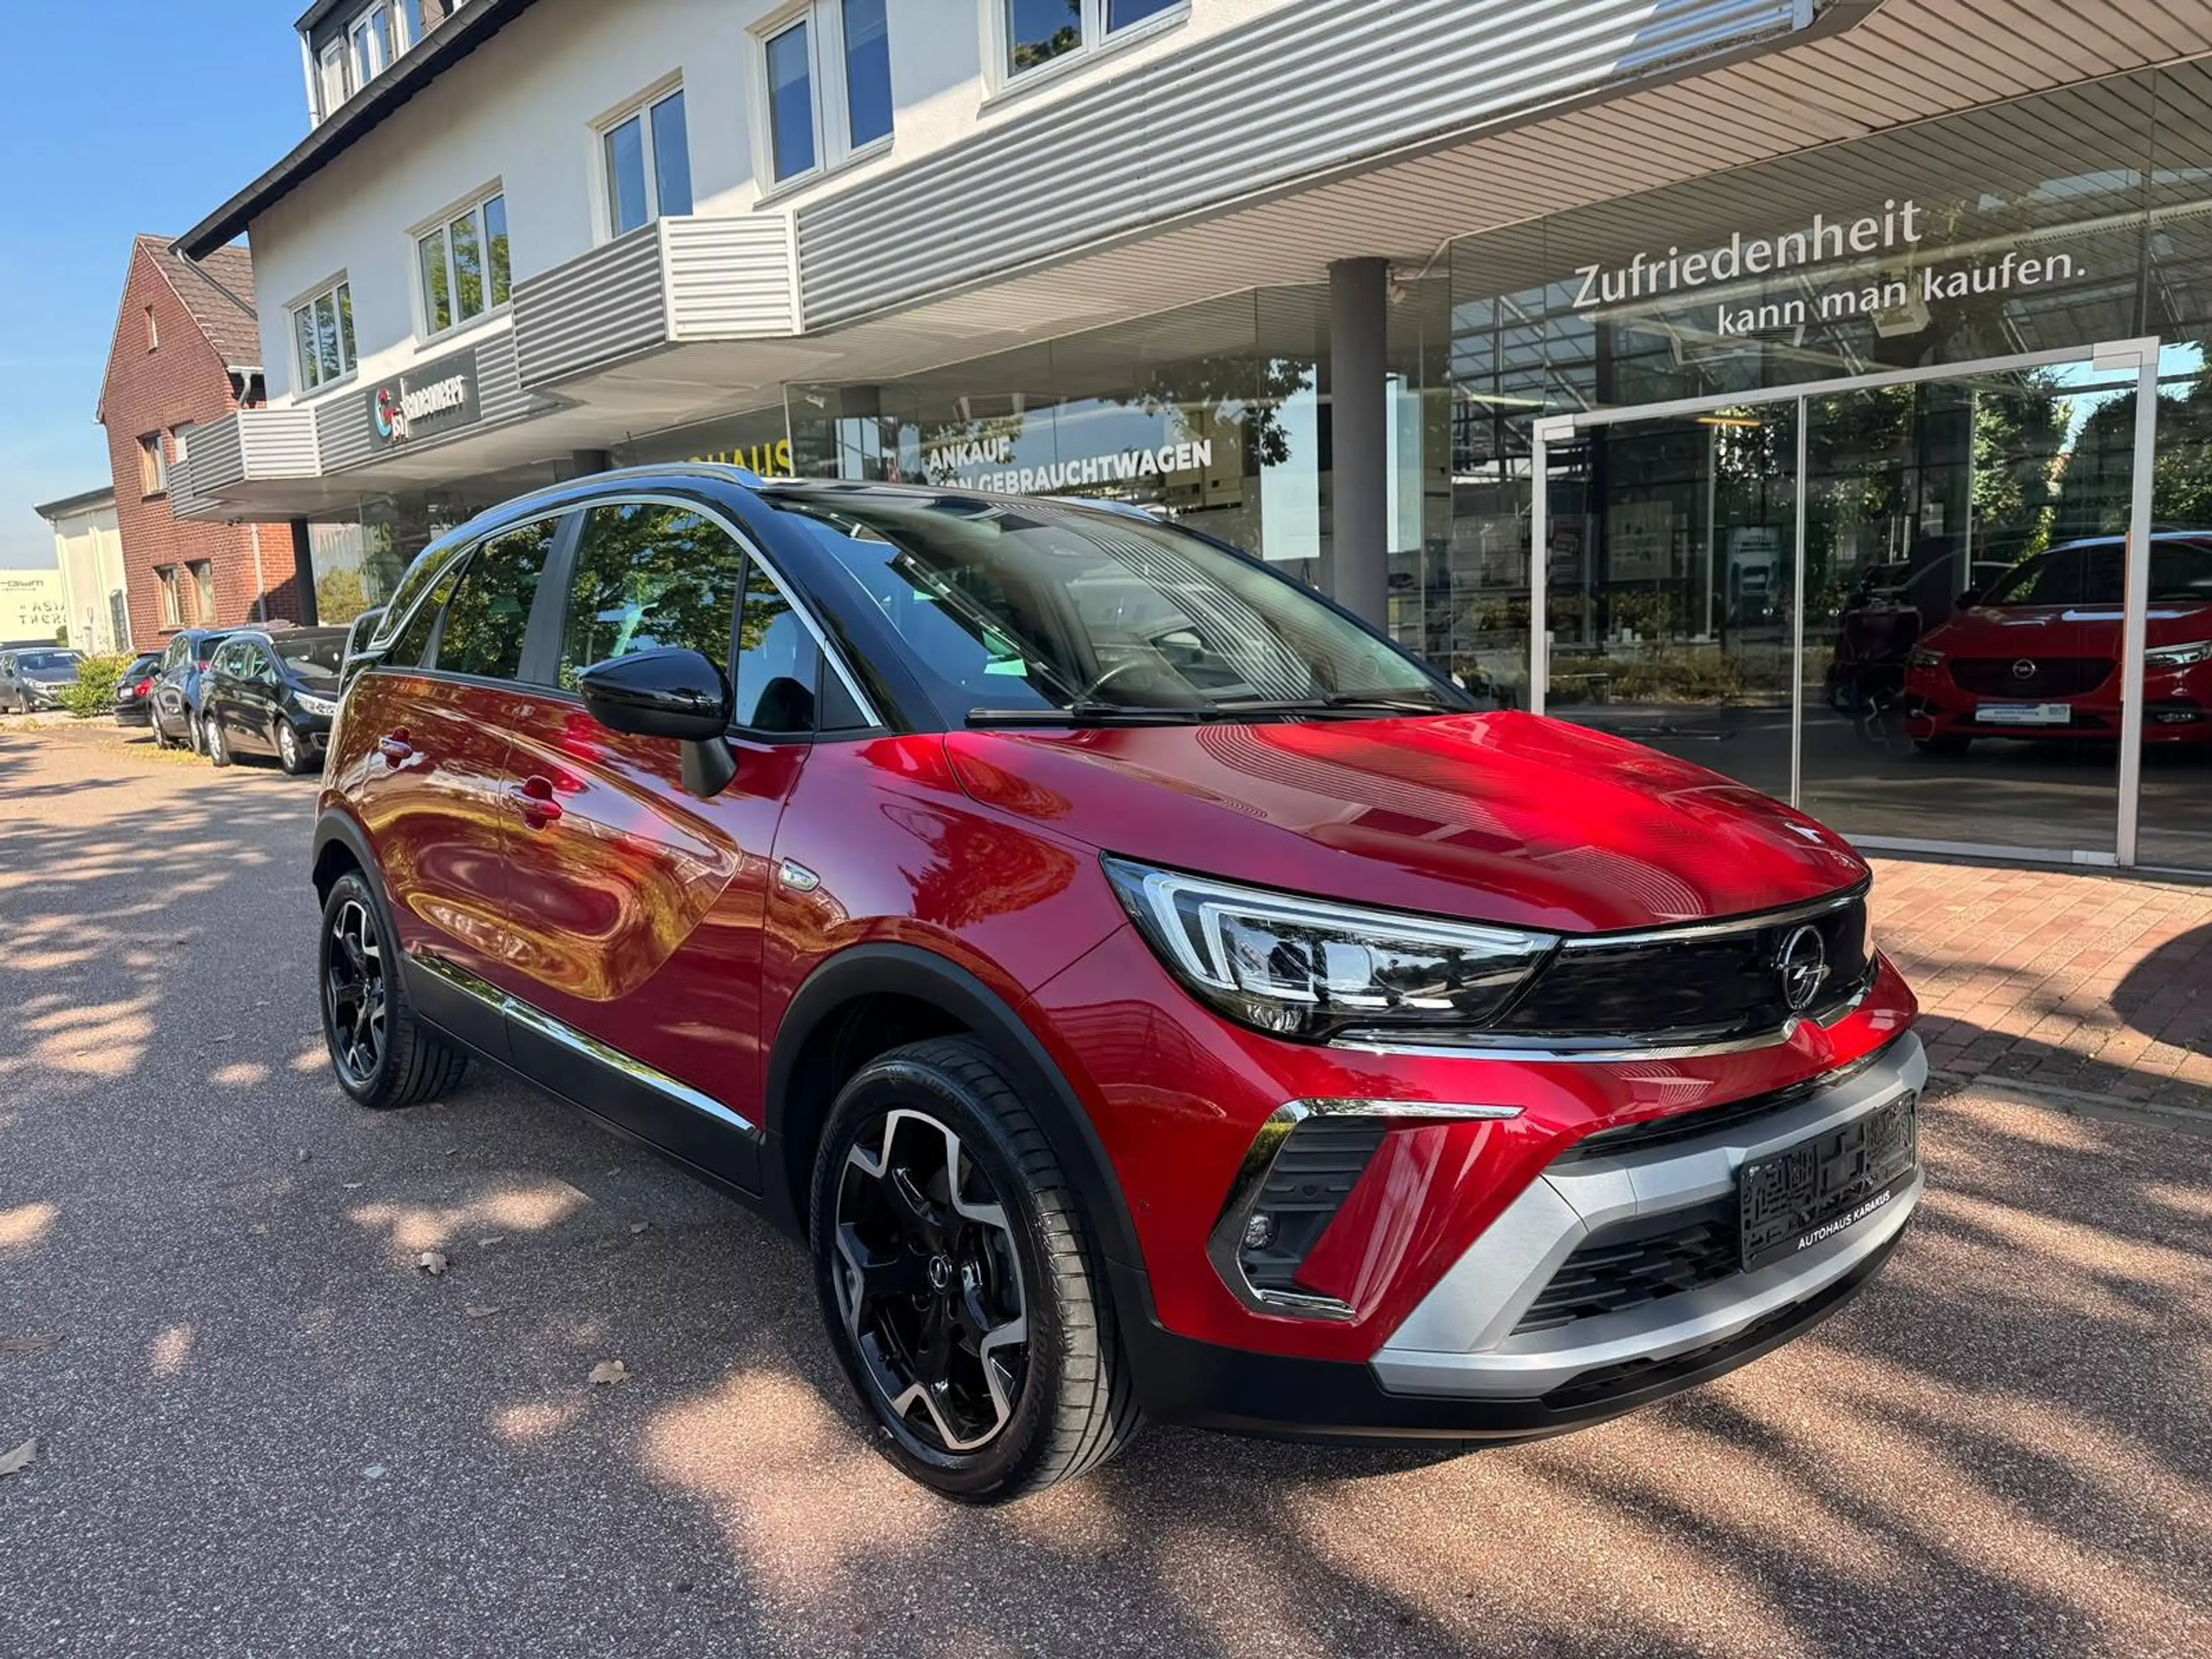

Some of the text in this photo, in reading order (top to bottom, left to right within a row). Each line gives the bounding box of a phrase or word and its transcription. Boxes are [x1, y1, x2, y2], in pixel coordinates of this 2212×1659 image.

[1573, 199, 1921, 309] Zufriedenheit
[1718, 252, 2086, 336] kann man kaufen.
[929, 435, 1010, 471] ANKAUF
[979, 438, 1212, 495] GEBRAUCHTWAGEN
[1797, 1190, 1891, 1250] AUTOHAUS KARAKUS
